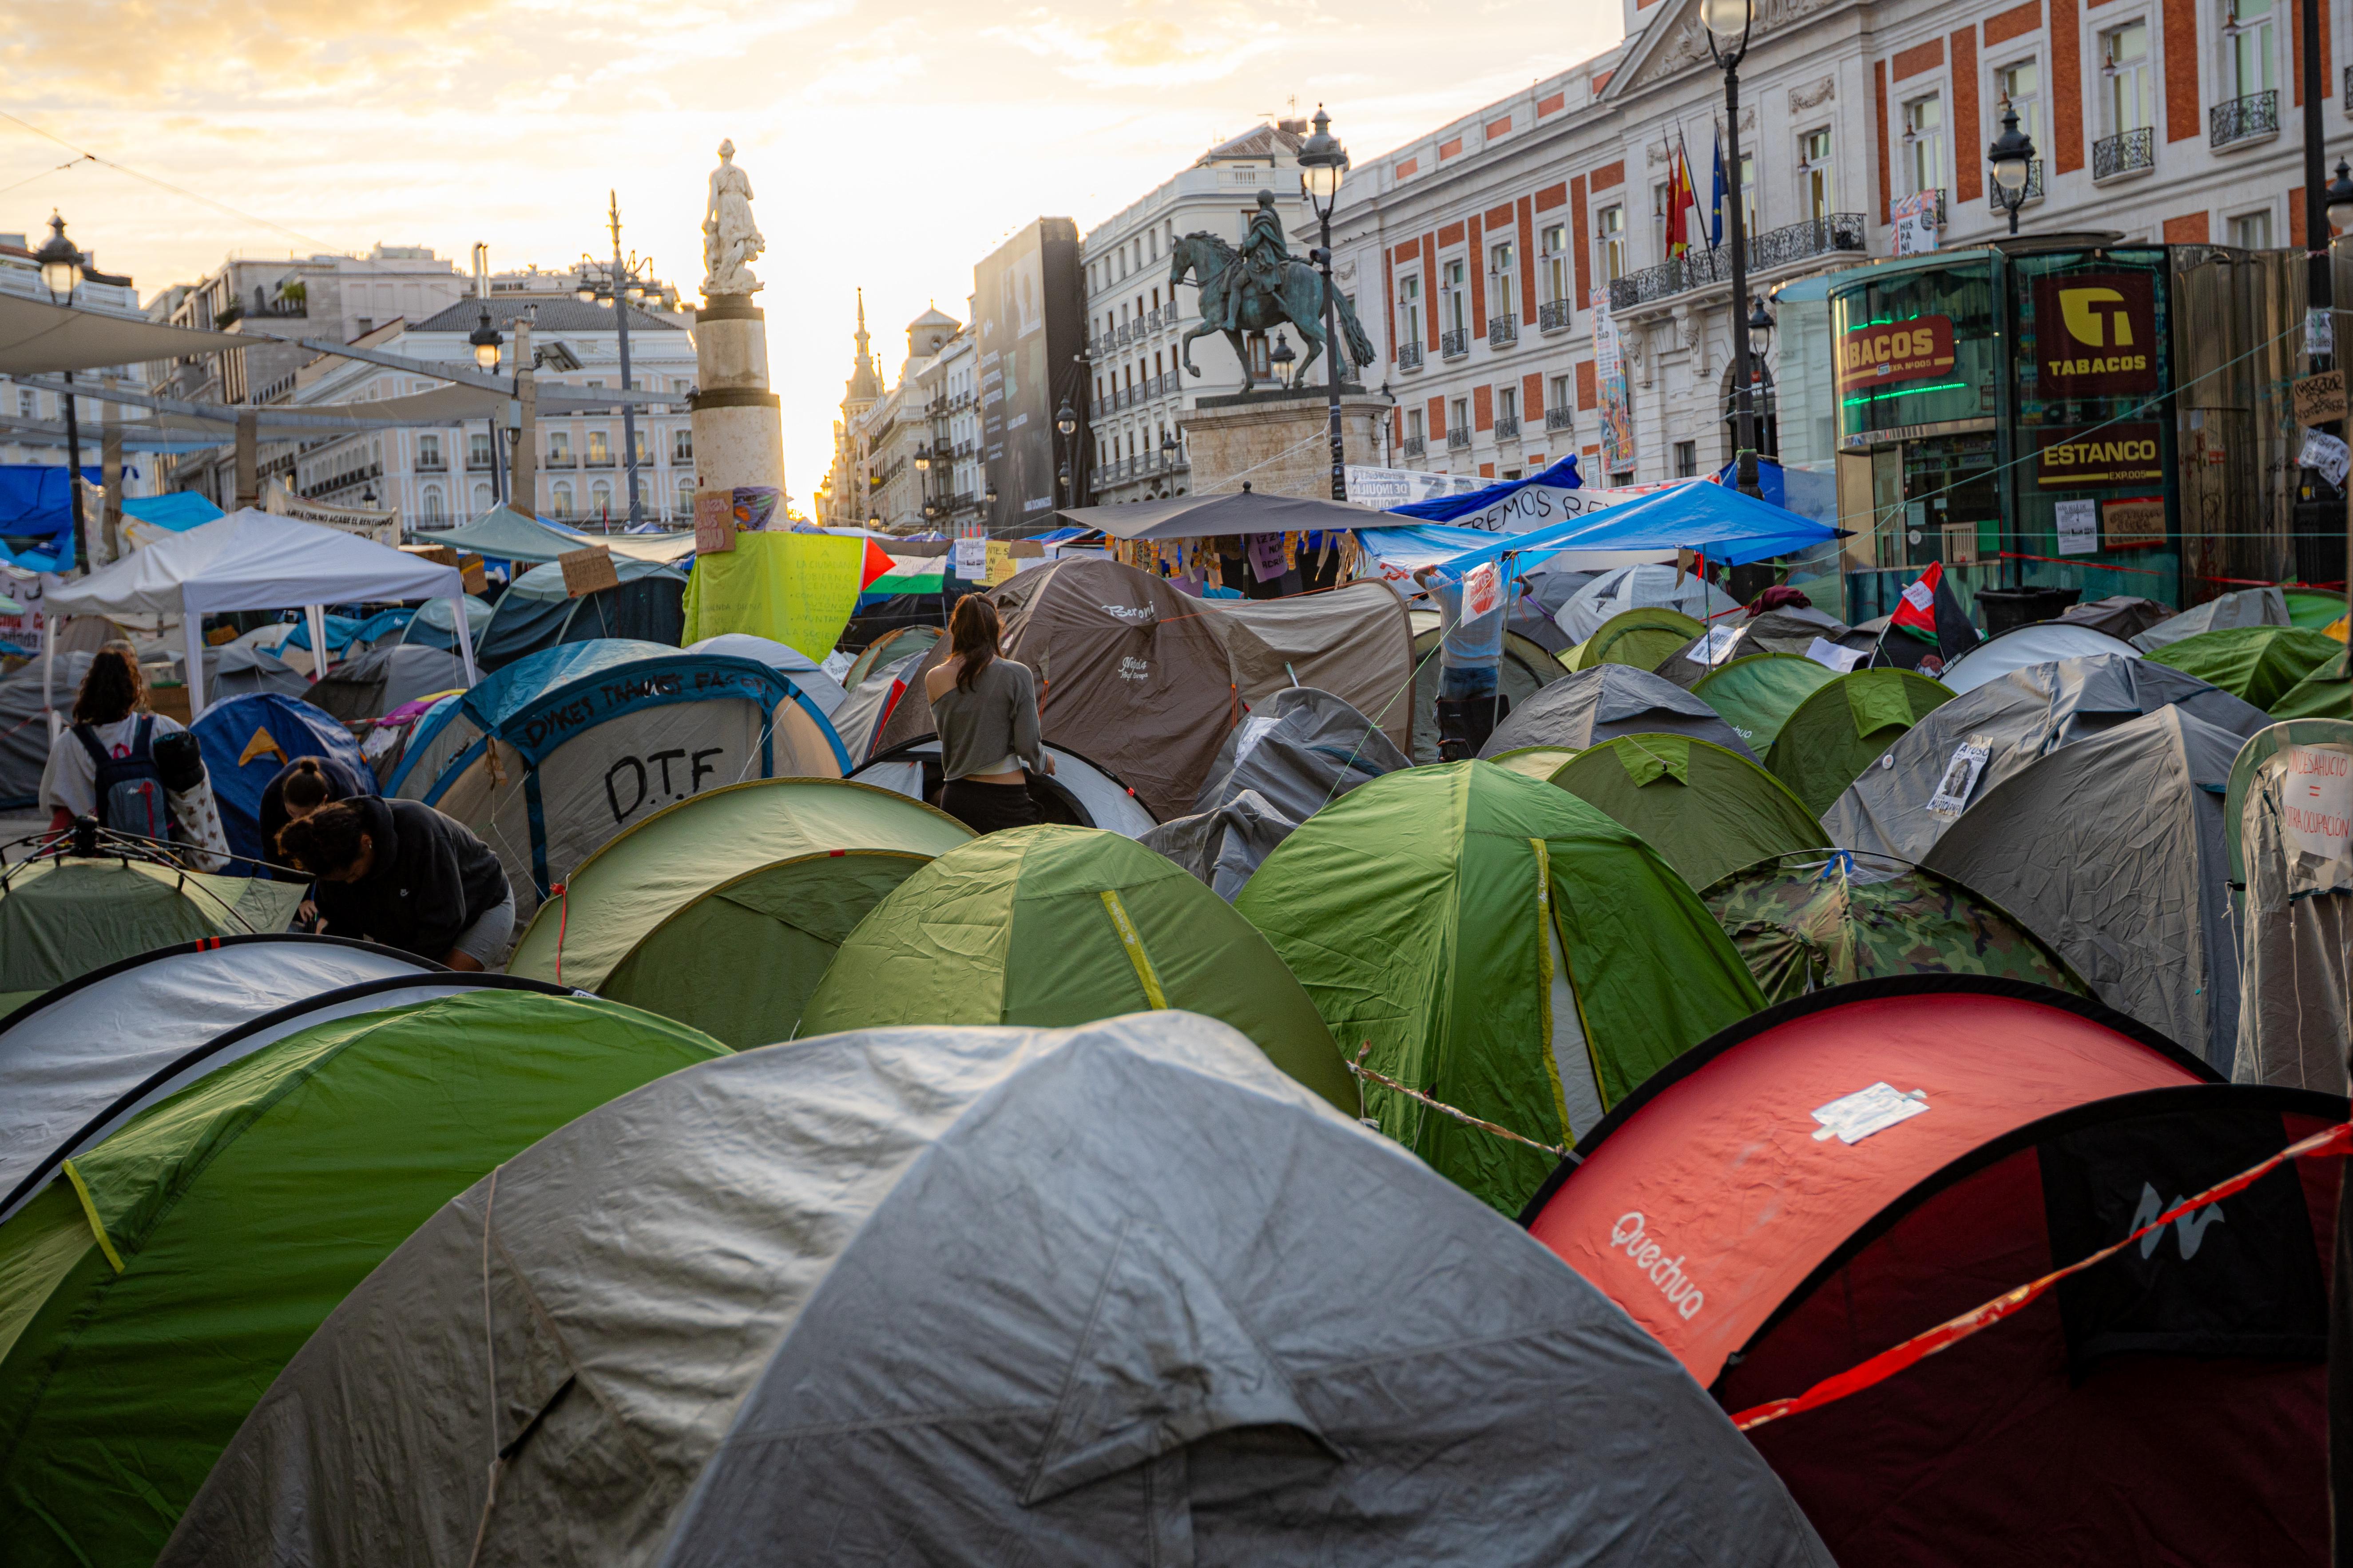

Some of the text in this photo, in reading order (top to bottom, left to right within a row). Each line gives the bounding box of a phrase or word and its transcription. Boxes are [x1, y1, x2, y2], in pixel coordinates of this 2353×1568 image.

[1900, 220, 1913, 231] HIS
[1901, 232, 1912, 242] PA
[1901, 242, 1909, 252] NI
[2048, 355, 2146, 376] TABACOS
[2044, 440, 2156, 466] ESTANCO
[1471, 573, 1491, 591] STOP
[1101, 601, 1154, 620] Beroni
[524, 697, 594, 748] DYKES
[1959, 744, 1989, 756] AYUSO
[2298, 751, 2348, 777] DESAHUCIO
[2286, 805, 2350, 839] OTRA OCUPACIÓN
[1610, 1211, 1704, 1320] Quechua
